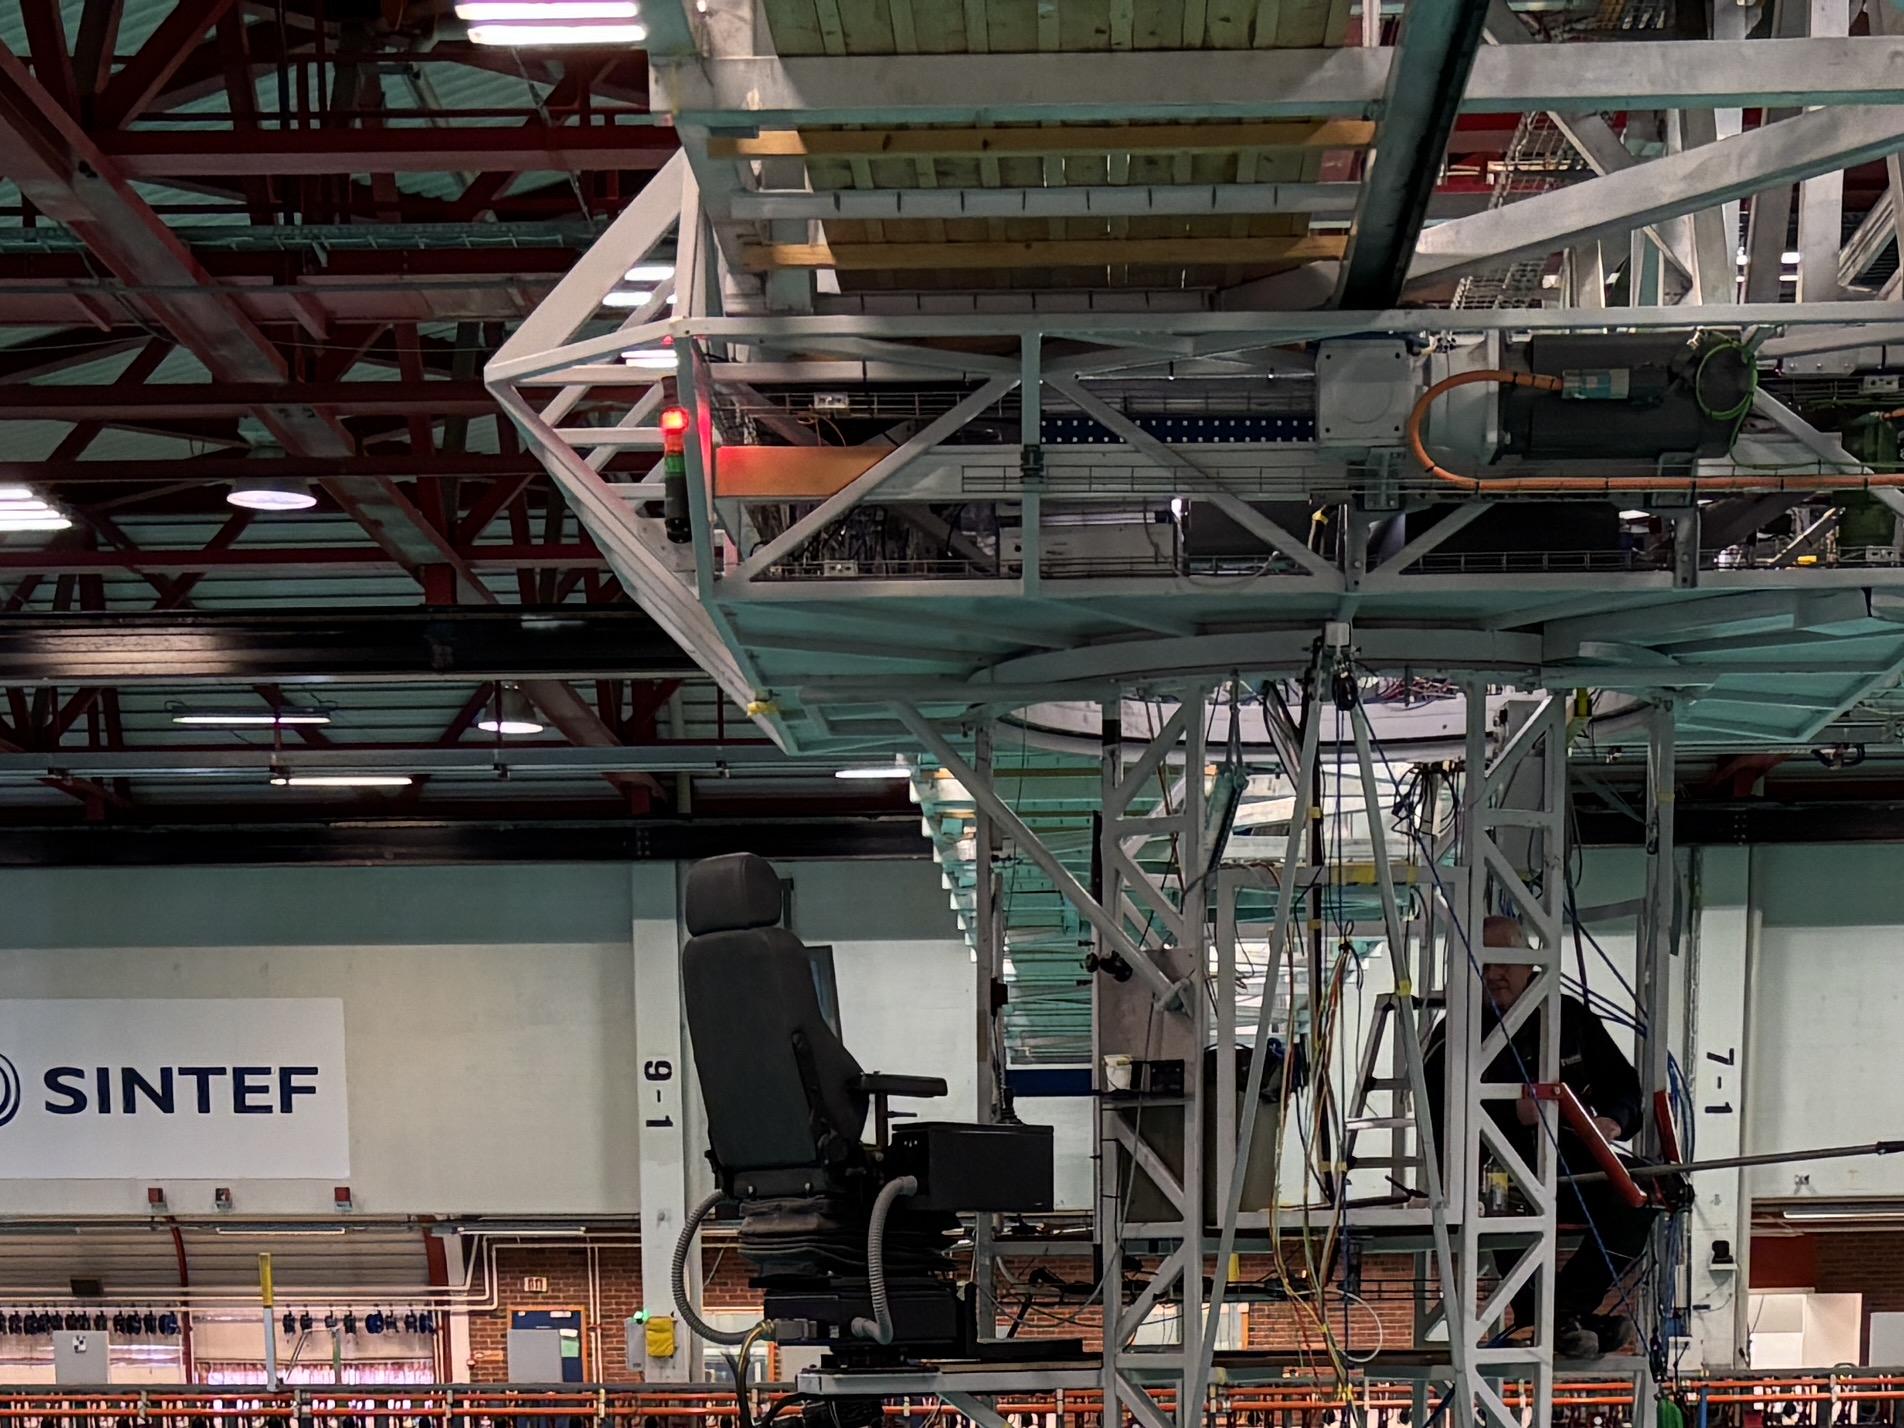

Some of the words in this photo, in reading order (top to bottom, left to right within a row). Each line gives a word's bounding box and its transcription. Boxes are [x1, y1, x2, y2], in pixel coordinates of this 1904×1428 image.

[43, 1066, 319, 1115] SINTEF
[643, 1060, 674, 1128] 9-1
[1704, 1047, 1735, 1114] 7-1
